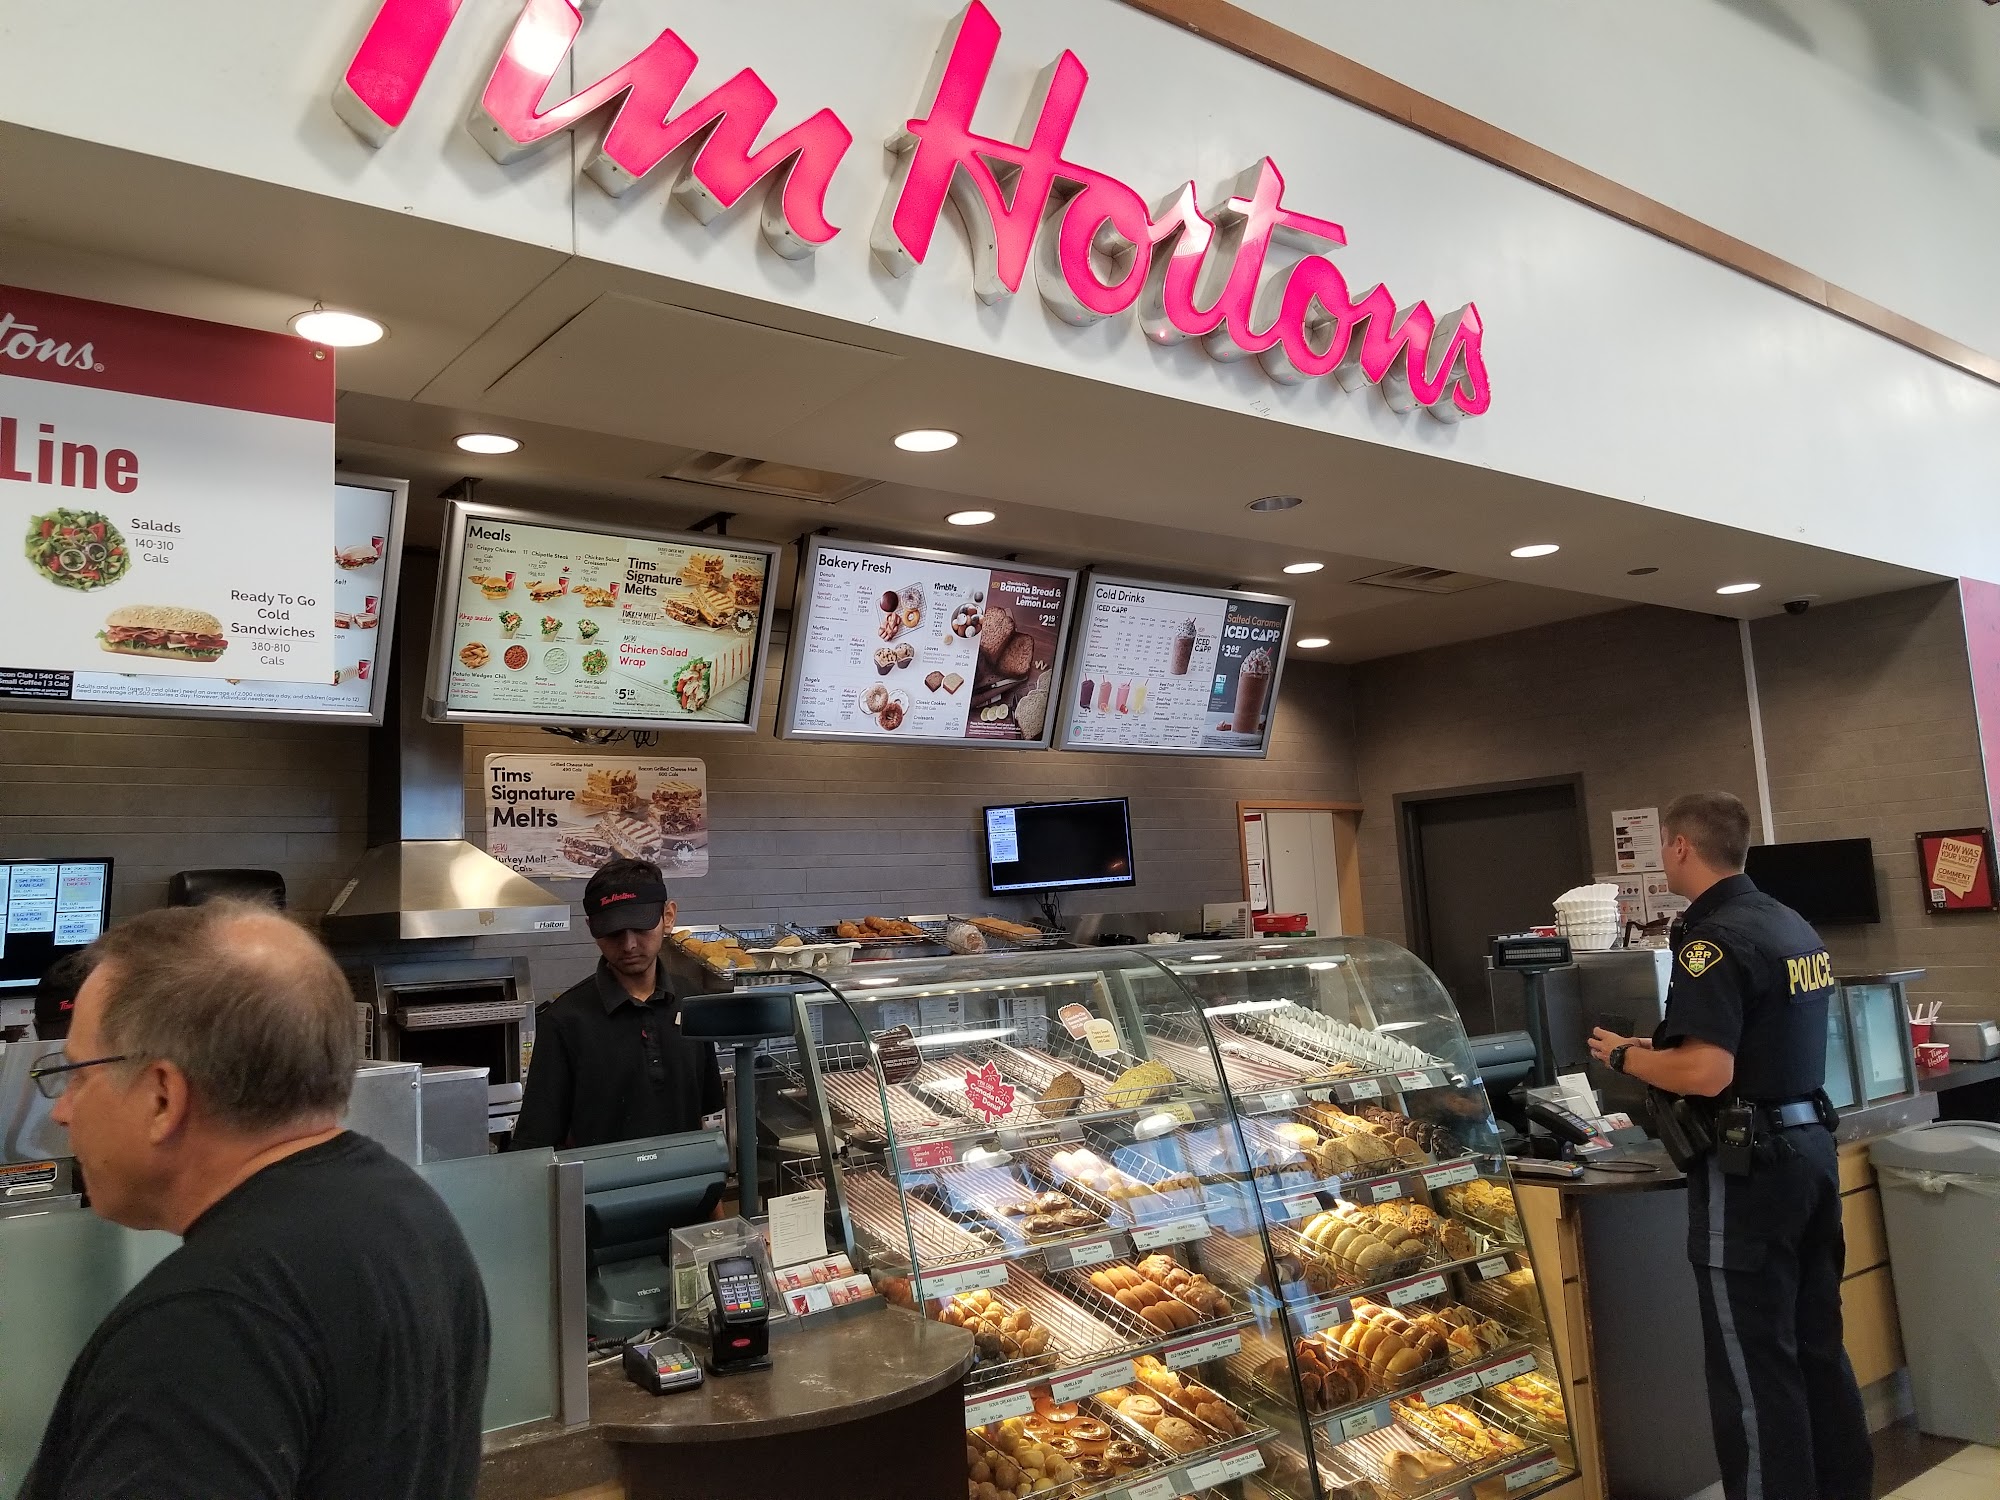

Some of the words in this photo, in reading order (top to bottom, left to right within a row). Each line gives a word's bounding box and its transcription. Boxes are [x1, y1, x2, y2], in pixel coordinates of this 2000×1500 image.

[890, 0, 1493, 417] Hortons
[0, 416, 139, 494] Line
[130, 518, 182, 534] Salads
[468, 525, 512, 542] Meals
[134, 538, 175, 551] 140-310
[142, 552, 170, 564] Cals
[627, 557, 658, 572] Tims
[818, 553, 860, 572] Bakery
[861, 559, 892, 574] Fresh
[625, 570, 683, 586] Signature
[624, 582, 658, 597] Melts
[1000, 582, 1031, 595] Banana
[1031, 584, 1055, 597] Bread
[1055, 587, 1062, 598] &
[1096, 587, 1116, 601] Cold
[1118, 590, 1146, 604] Drinks
[230, 589, 275, 606] Ready
[277, 593, 294, 605] To
[297, 595, 317, 607] Go
[1015, 597, 1042, 609] Lemon
[1043, 600, 1060, 611] Loaf
[257, 608, 291, 621] Cold
[1096, 603, 1111, 612] ICED
[1226, 613, 1251, 626] Salted
[1251, 616, 1282, 629] Caramel
[230, 622, 316, 639] Sandwiches
[1224, 624, 1250, 640] ICED
[251, 641, 292, 653] 380-810
[1195, 637, 1211, 646] ICED
[619, 643, 659, 656] Chicken
[660, 646, 688, 658] Salad
[260, 655, 286, 666] Cals
[619, 656, 646, 669] Wrap
[54, 674, 70, 682] Cals
[490, 766, 532, 783] Tims
[490, 784, 576, 805] Signature
[492, 806, 559, 829] Melts
[1940, 850, 1957, 860] YOUR
[1941, 841, 1961, 854] HOW
[1961, 846, 1980, 858] WAS
[525, 854, 547, 864] Melt
[1937, 867, 1972, 881] COMMENT
[1786, 951, 1835, 996] POLICE
[970, 1082, 995, 1102] Canada
[994, 1096, 1008, 1109] Day
[982, 1096, 1001, 1112] Donut
[636, 1152, 658, 1163] micros
[636, 1286, 661, 1297] micros
